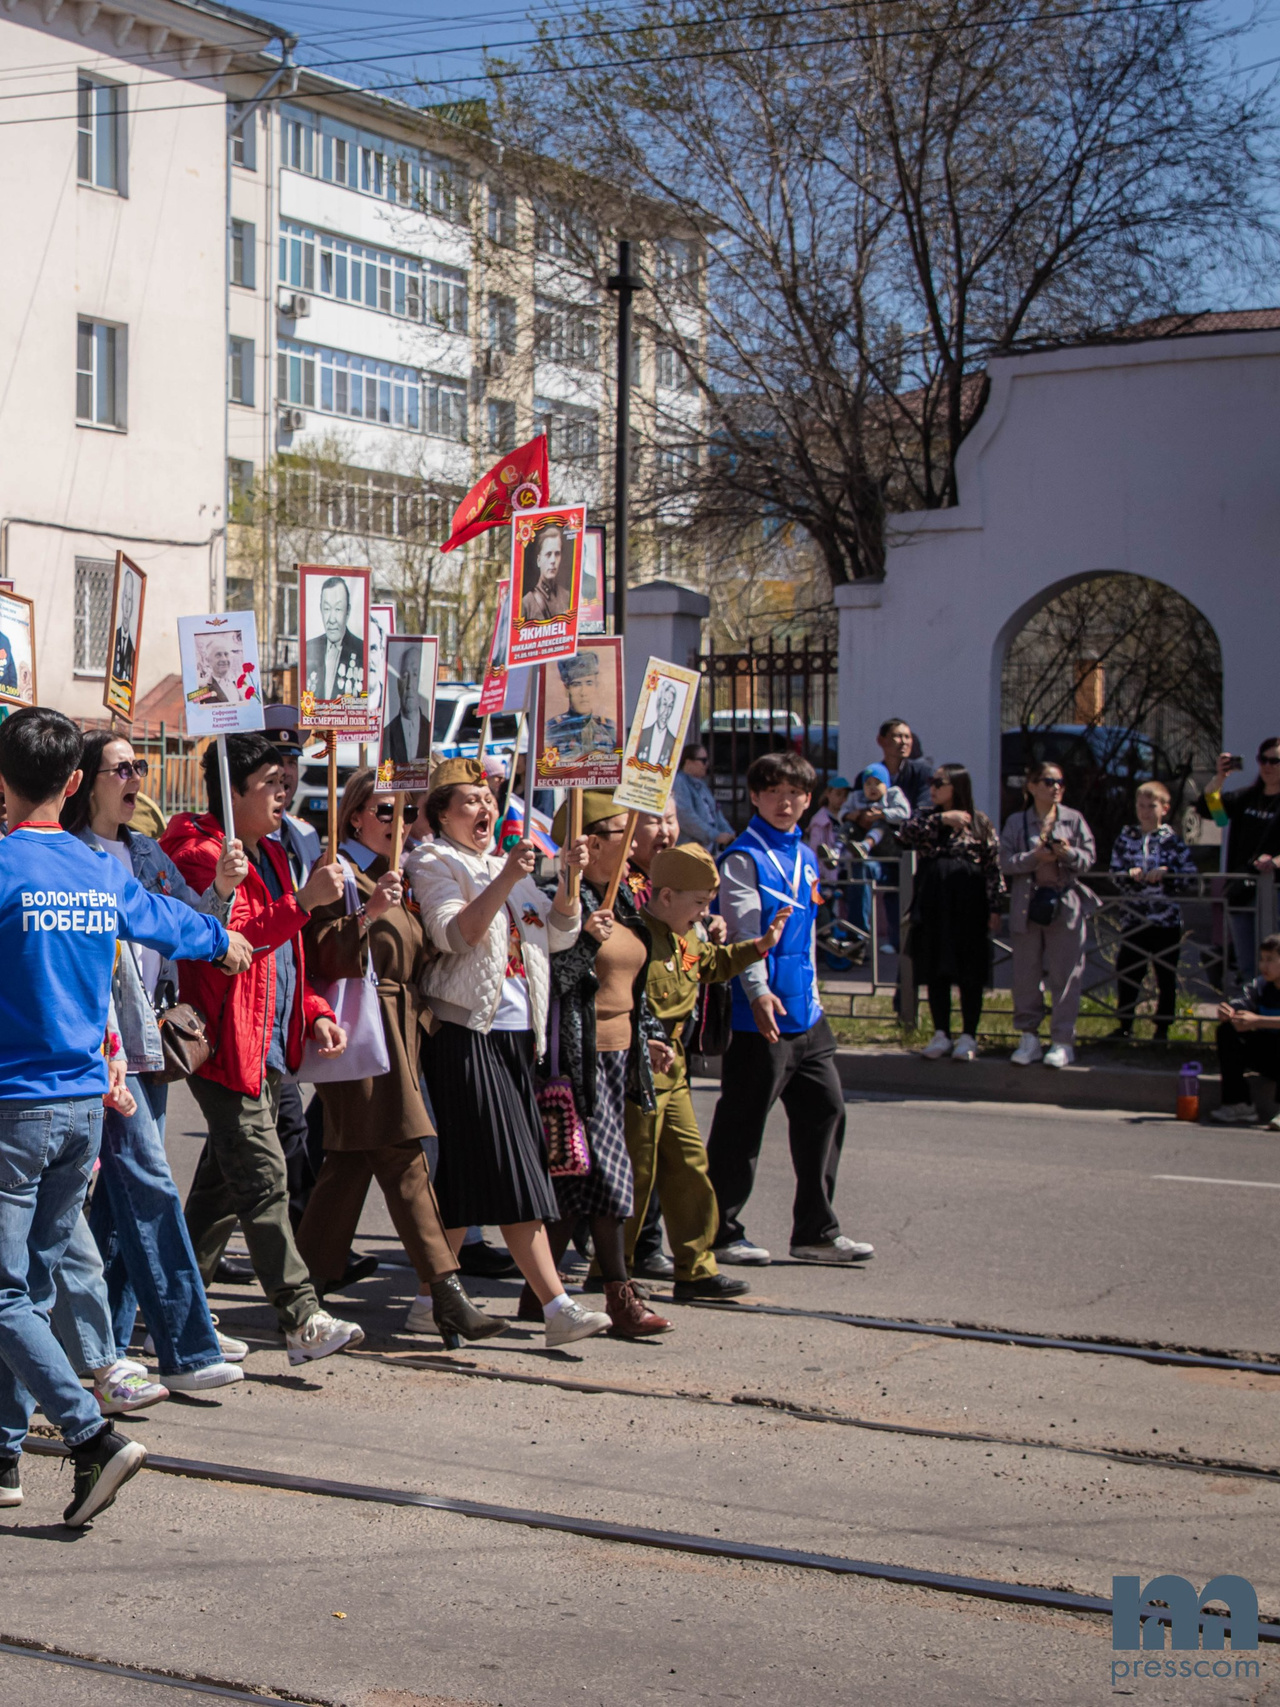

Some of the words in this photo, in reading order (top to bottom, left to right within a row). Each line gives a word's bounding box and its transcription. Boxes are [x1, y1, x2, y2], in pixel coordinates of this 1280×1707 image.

[519, 621, 567, 642] ЯКИМЕЦ
[511, 641, 537, 653] МИХАИЛ
[537, 635, 575, 648] АЛЕКСЕЕВИЧ
[302, 715, 349, 726] БЕССМЕРТНЫЙ
[349, 716, 366, 726] ПОЛК
[377, 779, 415, 789] БЕССМЕРТНЫЙ
[537, 777, 596, 787] БЕССМЕРТНЫЙ
[597, 776, 620, 785] ПОЛК
[22, 889, 117, 907] ВОЛОНТЁРЫ
[23, 910, 118, 934] ПОБЕДЫ
